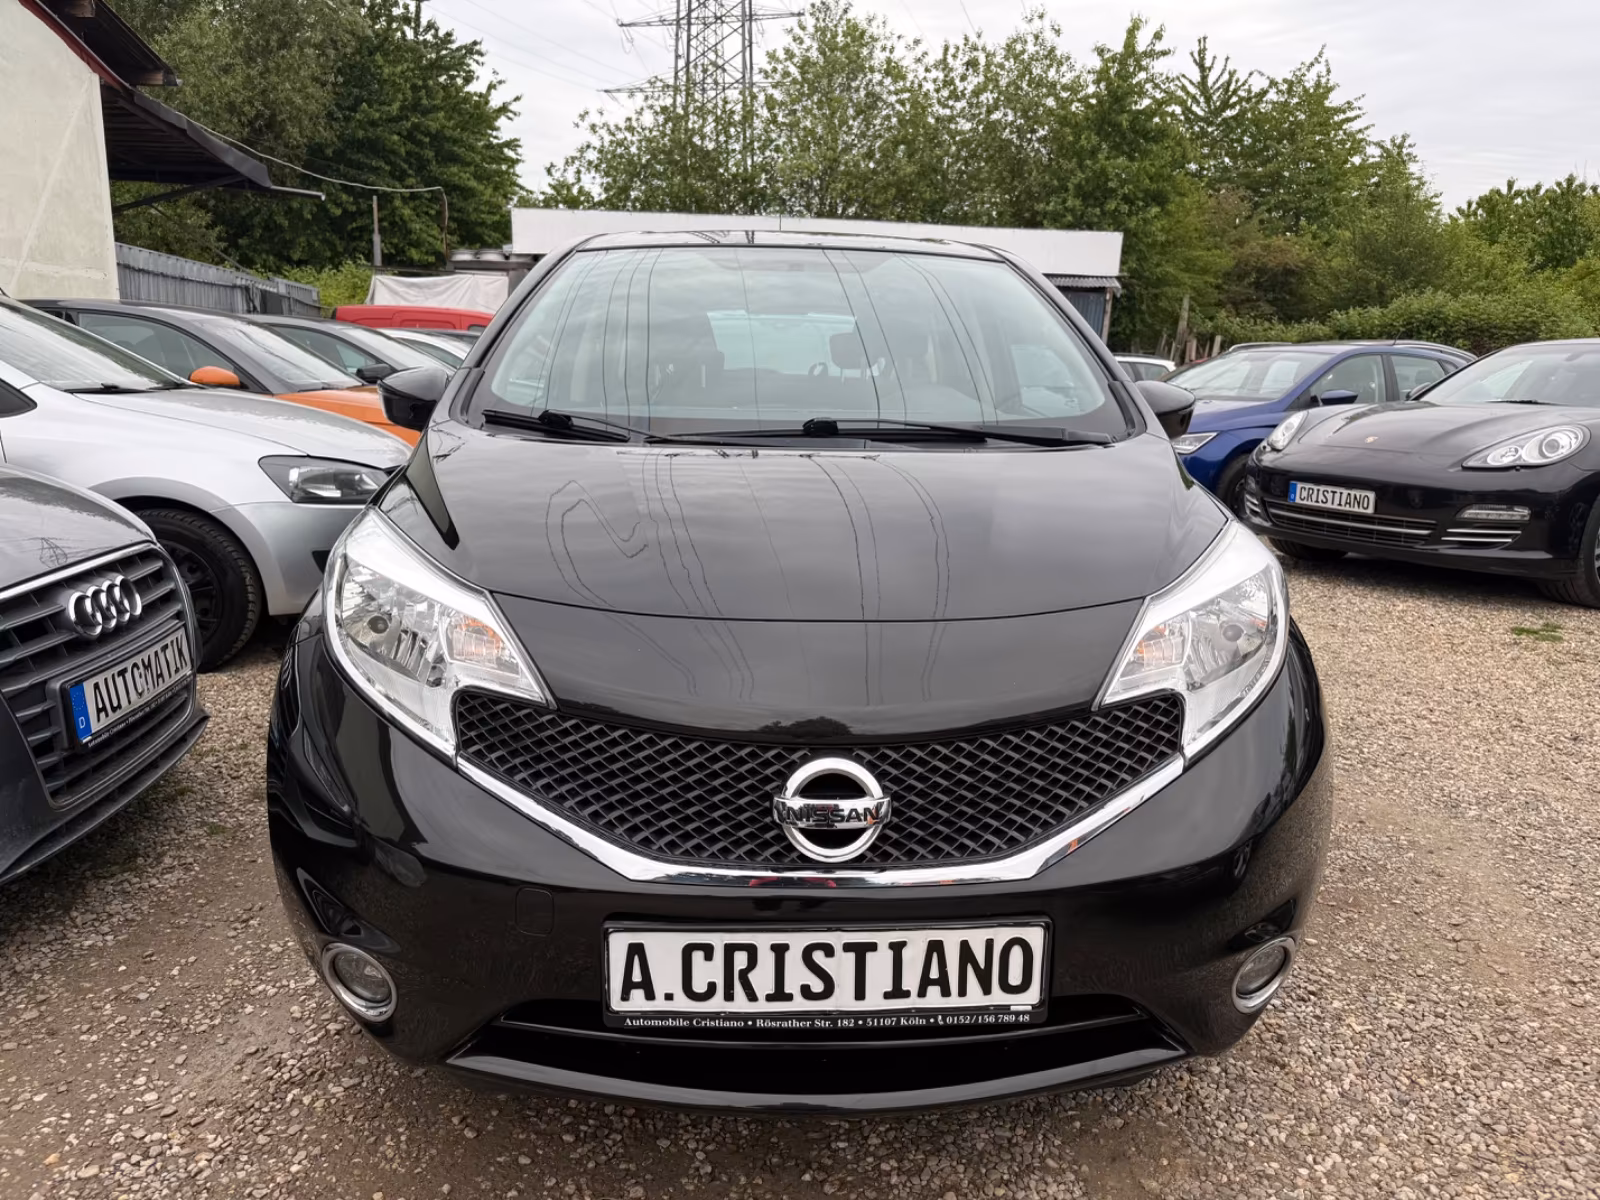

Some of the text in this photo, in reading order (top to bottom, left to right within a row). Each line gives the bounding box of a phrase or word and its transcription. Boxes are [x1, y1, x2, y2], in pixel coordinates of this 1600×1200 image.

[1299, 486, 1370, 510] CRISTIANO
[78, 716, 86, 729] D
[785, 807, 880, 823] NISSAN
[620, 936, 1034, 1002] A.CRISTIANO
[624, 1013, 1030, 1028] Automobile Cristiano Rösrather Str. 182 51107 Köln 0152/156 789 48
